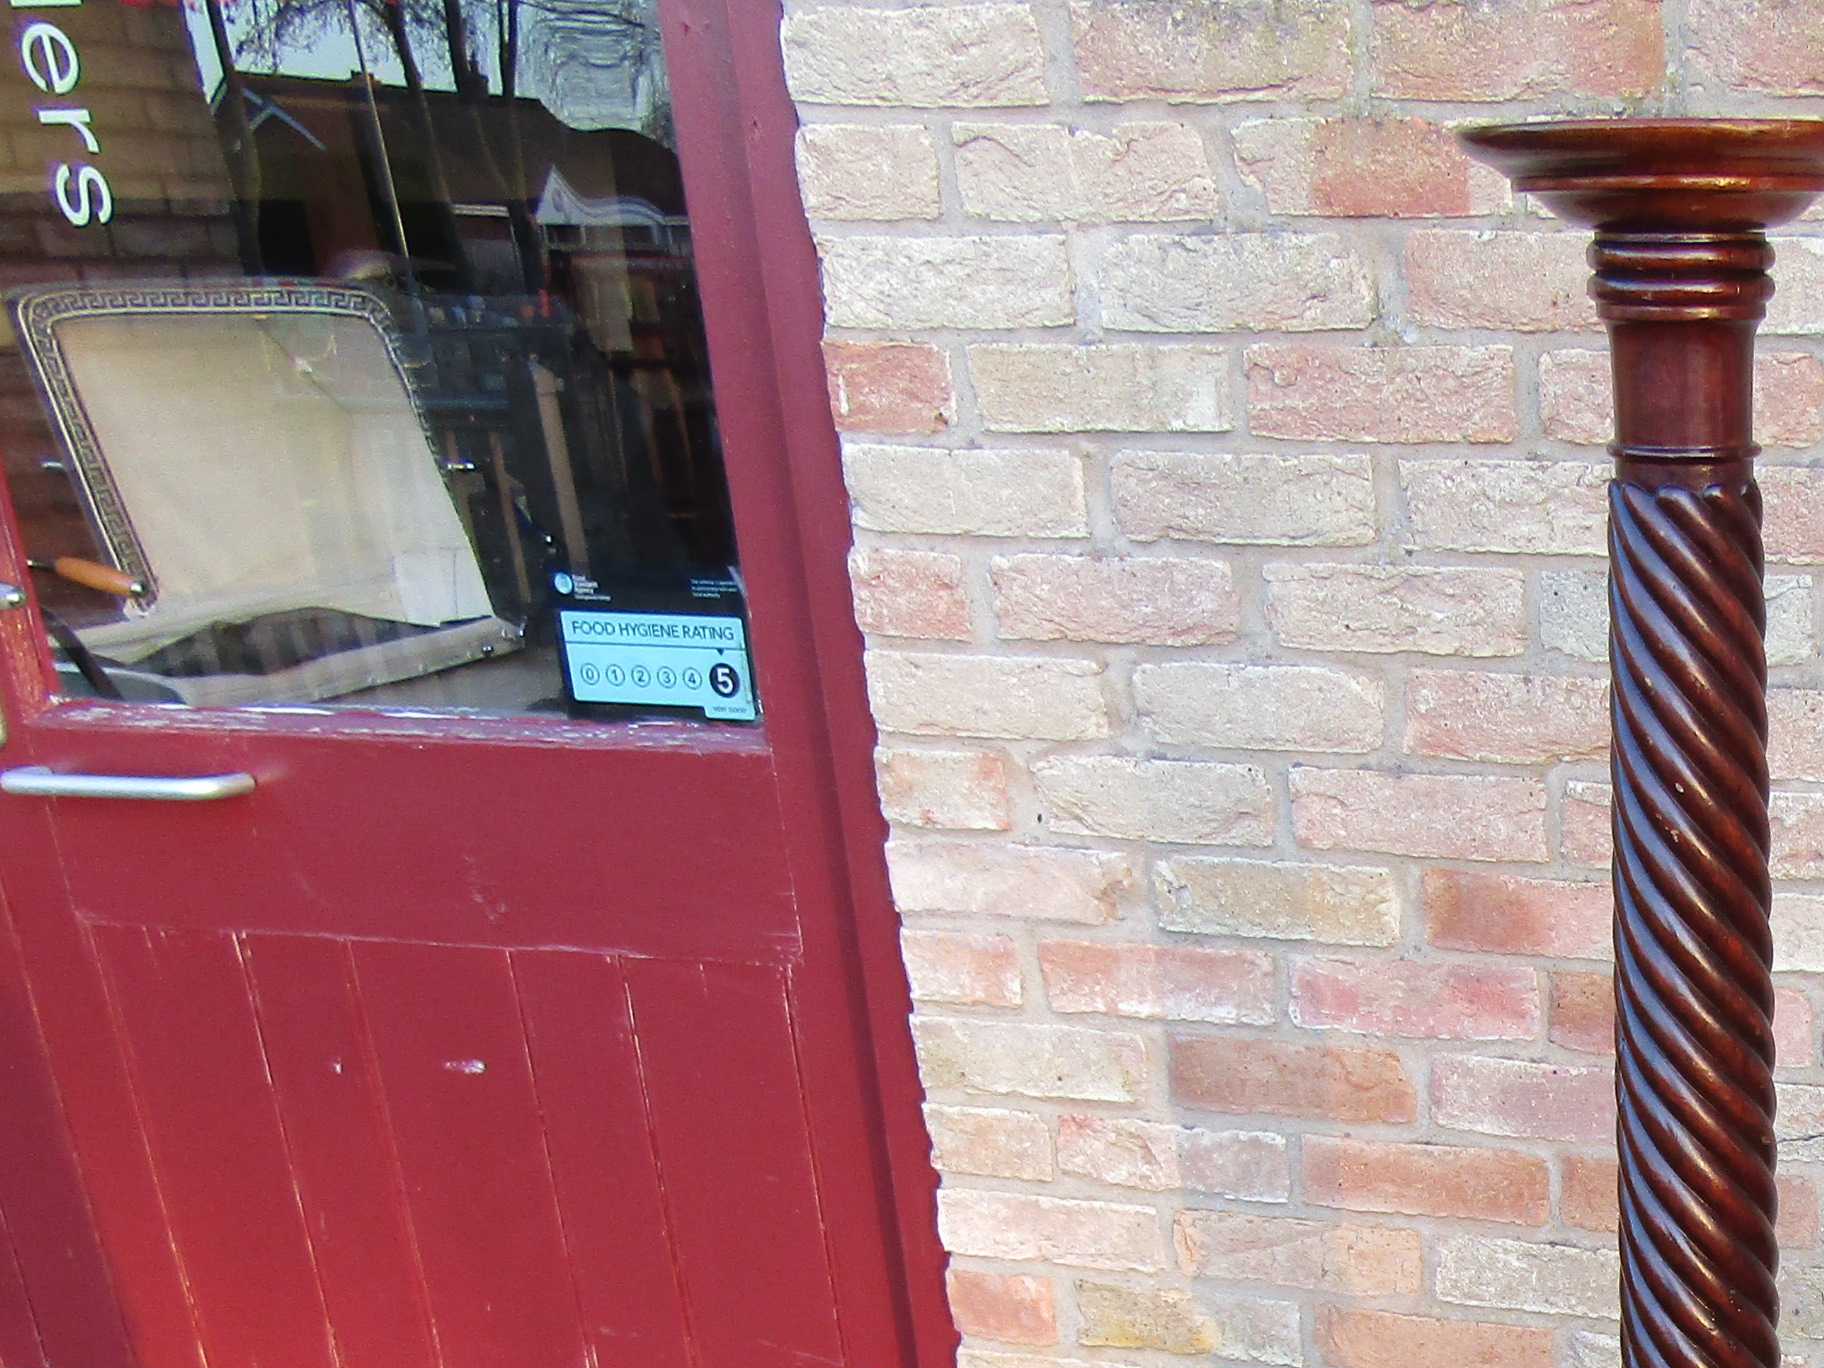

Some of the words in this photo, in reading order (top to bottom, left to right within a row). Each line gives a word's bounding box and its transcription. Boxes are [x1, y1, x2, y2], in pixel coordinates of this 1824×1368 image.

[572, 620, 616, 635] FOOD
[620, 623, 680, 638] HYGIENE
[683, 626, 734, 640] RATING
[716, 668, 734, 694] 5
